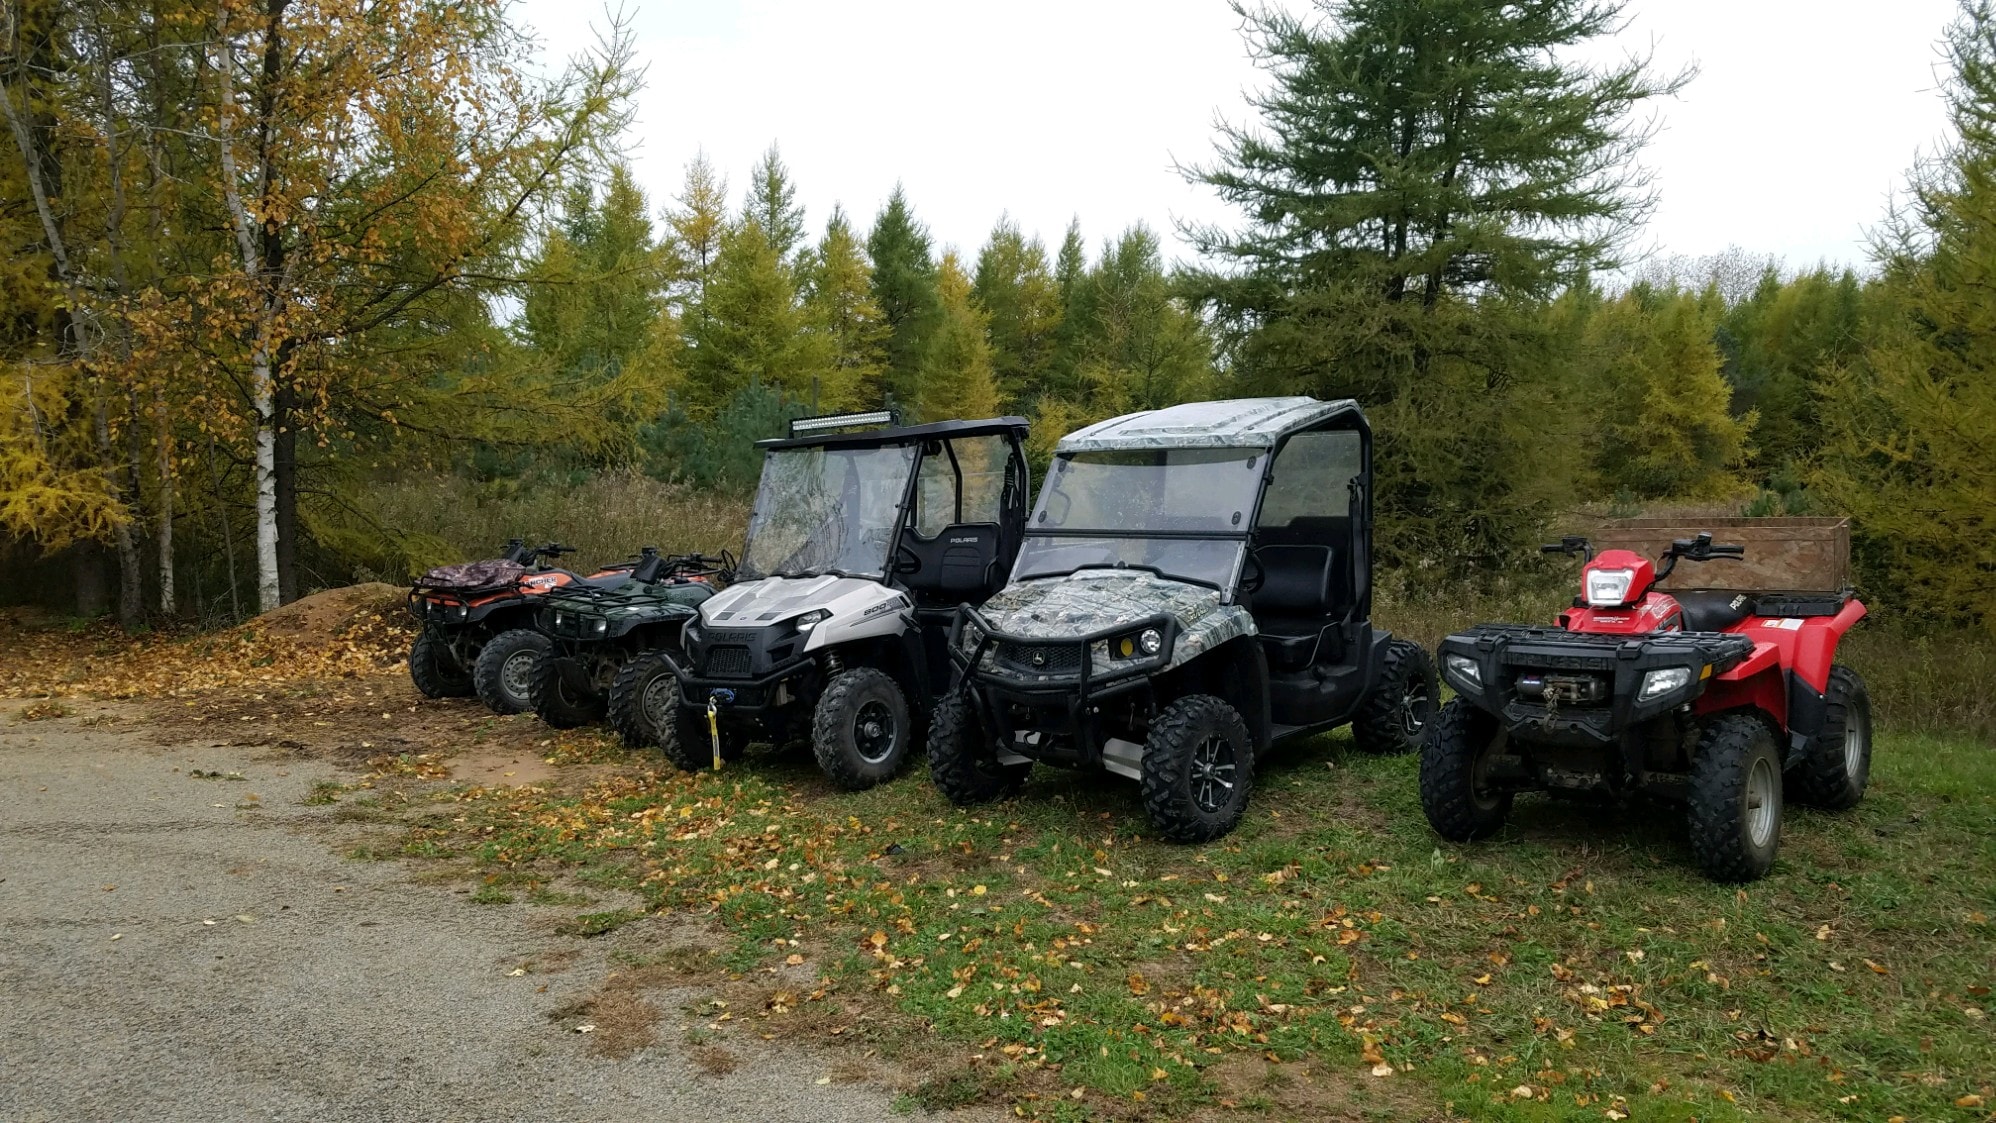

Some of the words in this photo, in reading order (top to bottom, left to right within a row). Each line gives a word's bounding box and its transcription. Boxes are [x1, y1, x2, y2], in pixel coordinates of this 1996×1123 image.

[950, 536, 979, 544] POLARIS
[521, 577, 557, 586] ANCHER
[863, 602, 887, 616] 800
[707, 632, 758, 643] POLARIS
